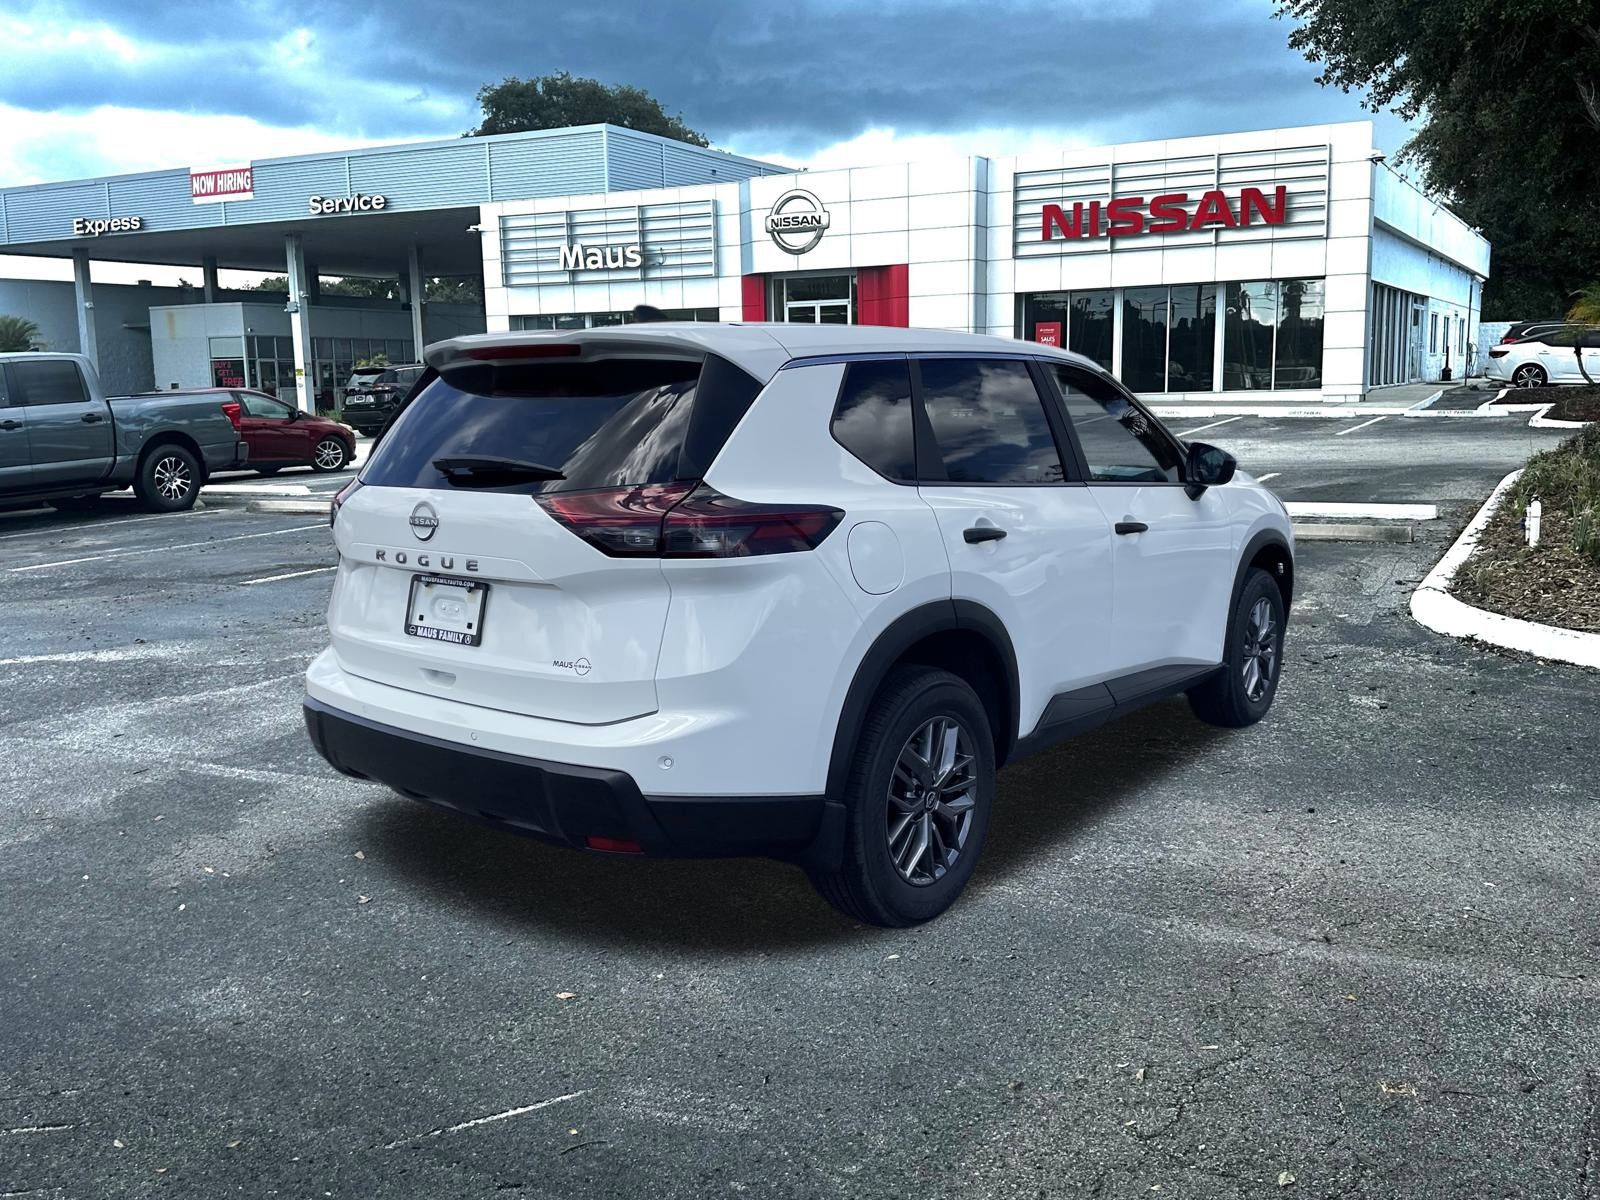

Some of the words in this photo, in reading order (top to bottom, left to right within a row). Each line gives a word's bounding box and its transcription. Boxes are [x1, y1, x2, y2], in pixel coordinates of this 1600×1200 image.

[192, 174, 215, 194] NOW
[216, 172, 251, 192] HIRING
[308, 193, 385, 215] Service
[1042, 185, 1287, 241] NISSAN
[72, 216, 141, 236] Express
[770, 215, 821, 228] NISSAN
[559, 243, 642, 270] Maus
[222, 377, 244, 386] FREE
[409, 518, 438, 526] NISSAN
[375, 548, 479, 572] ROGUE
[417, 626, 438, 639] MAUS
[438, 630, 464, 643] FAMILY
[552, 660, 573, 669] MAUS
